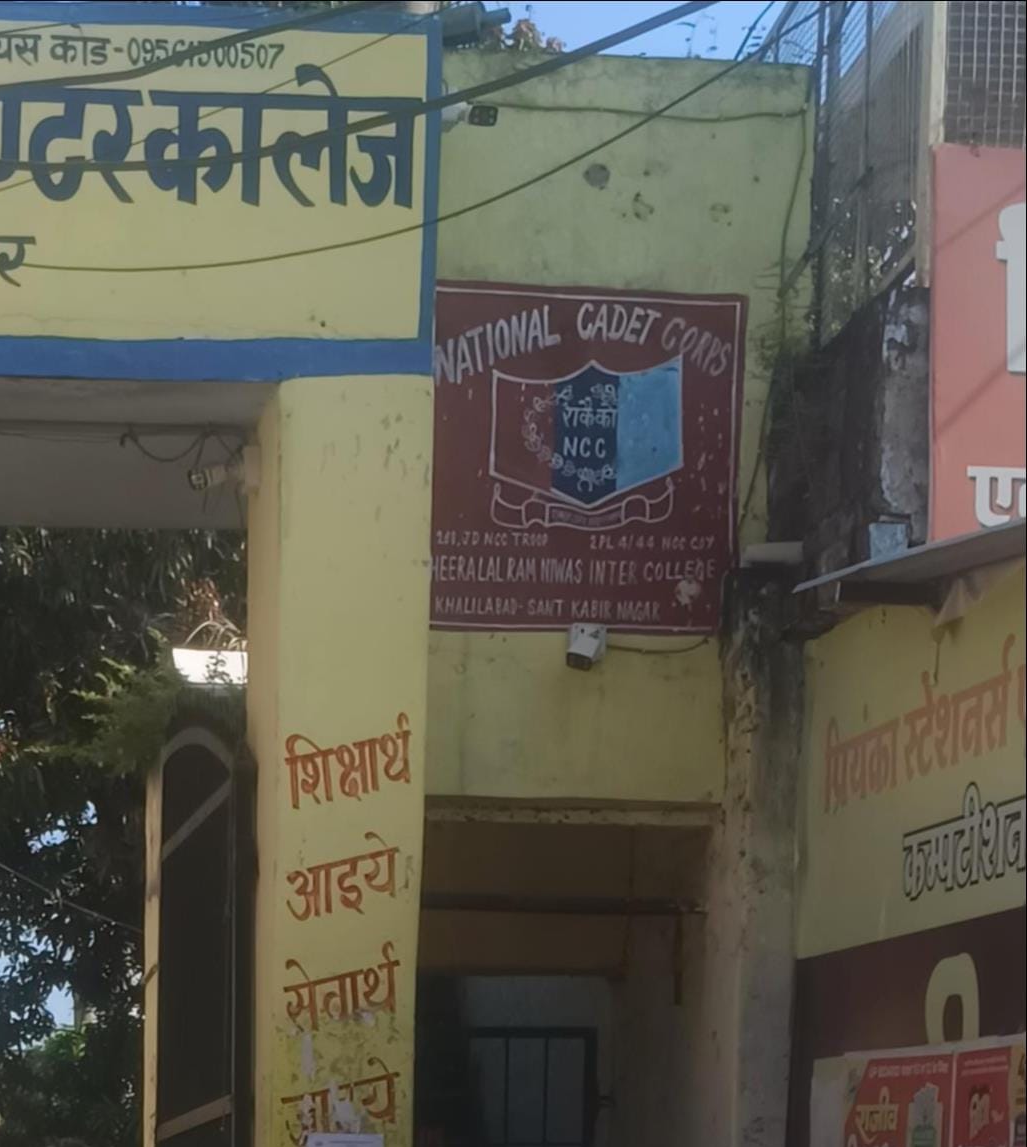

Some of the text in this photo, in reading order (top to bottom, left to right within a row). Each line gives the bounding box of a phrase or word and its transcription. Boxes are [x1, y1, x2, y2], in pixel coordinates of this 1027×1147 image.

[143, 64, 424, 209] कालेज
[434, 302, 733, 386] NATIONAL CADET CORPS
[563, 436, 606, 458] NCC
[540, 556, 583, 585] NIWAS
[589, 560, 638, 585] INTER
[570, 599, 612, 620] KABIR
[286, 831, 400, 921] आइये
